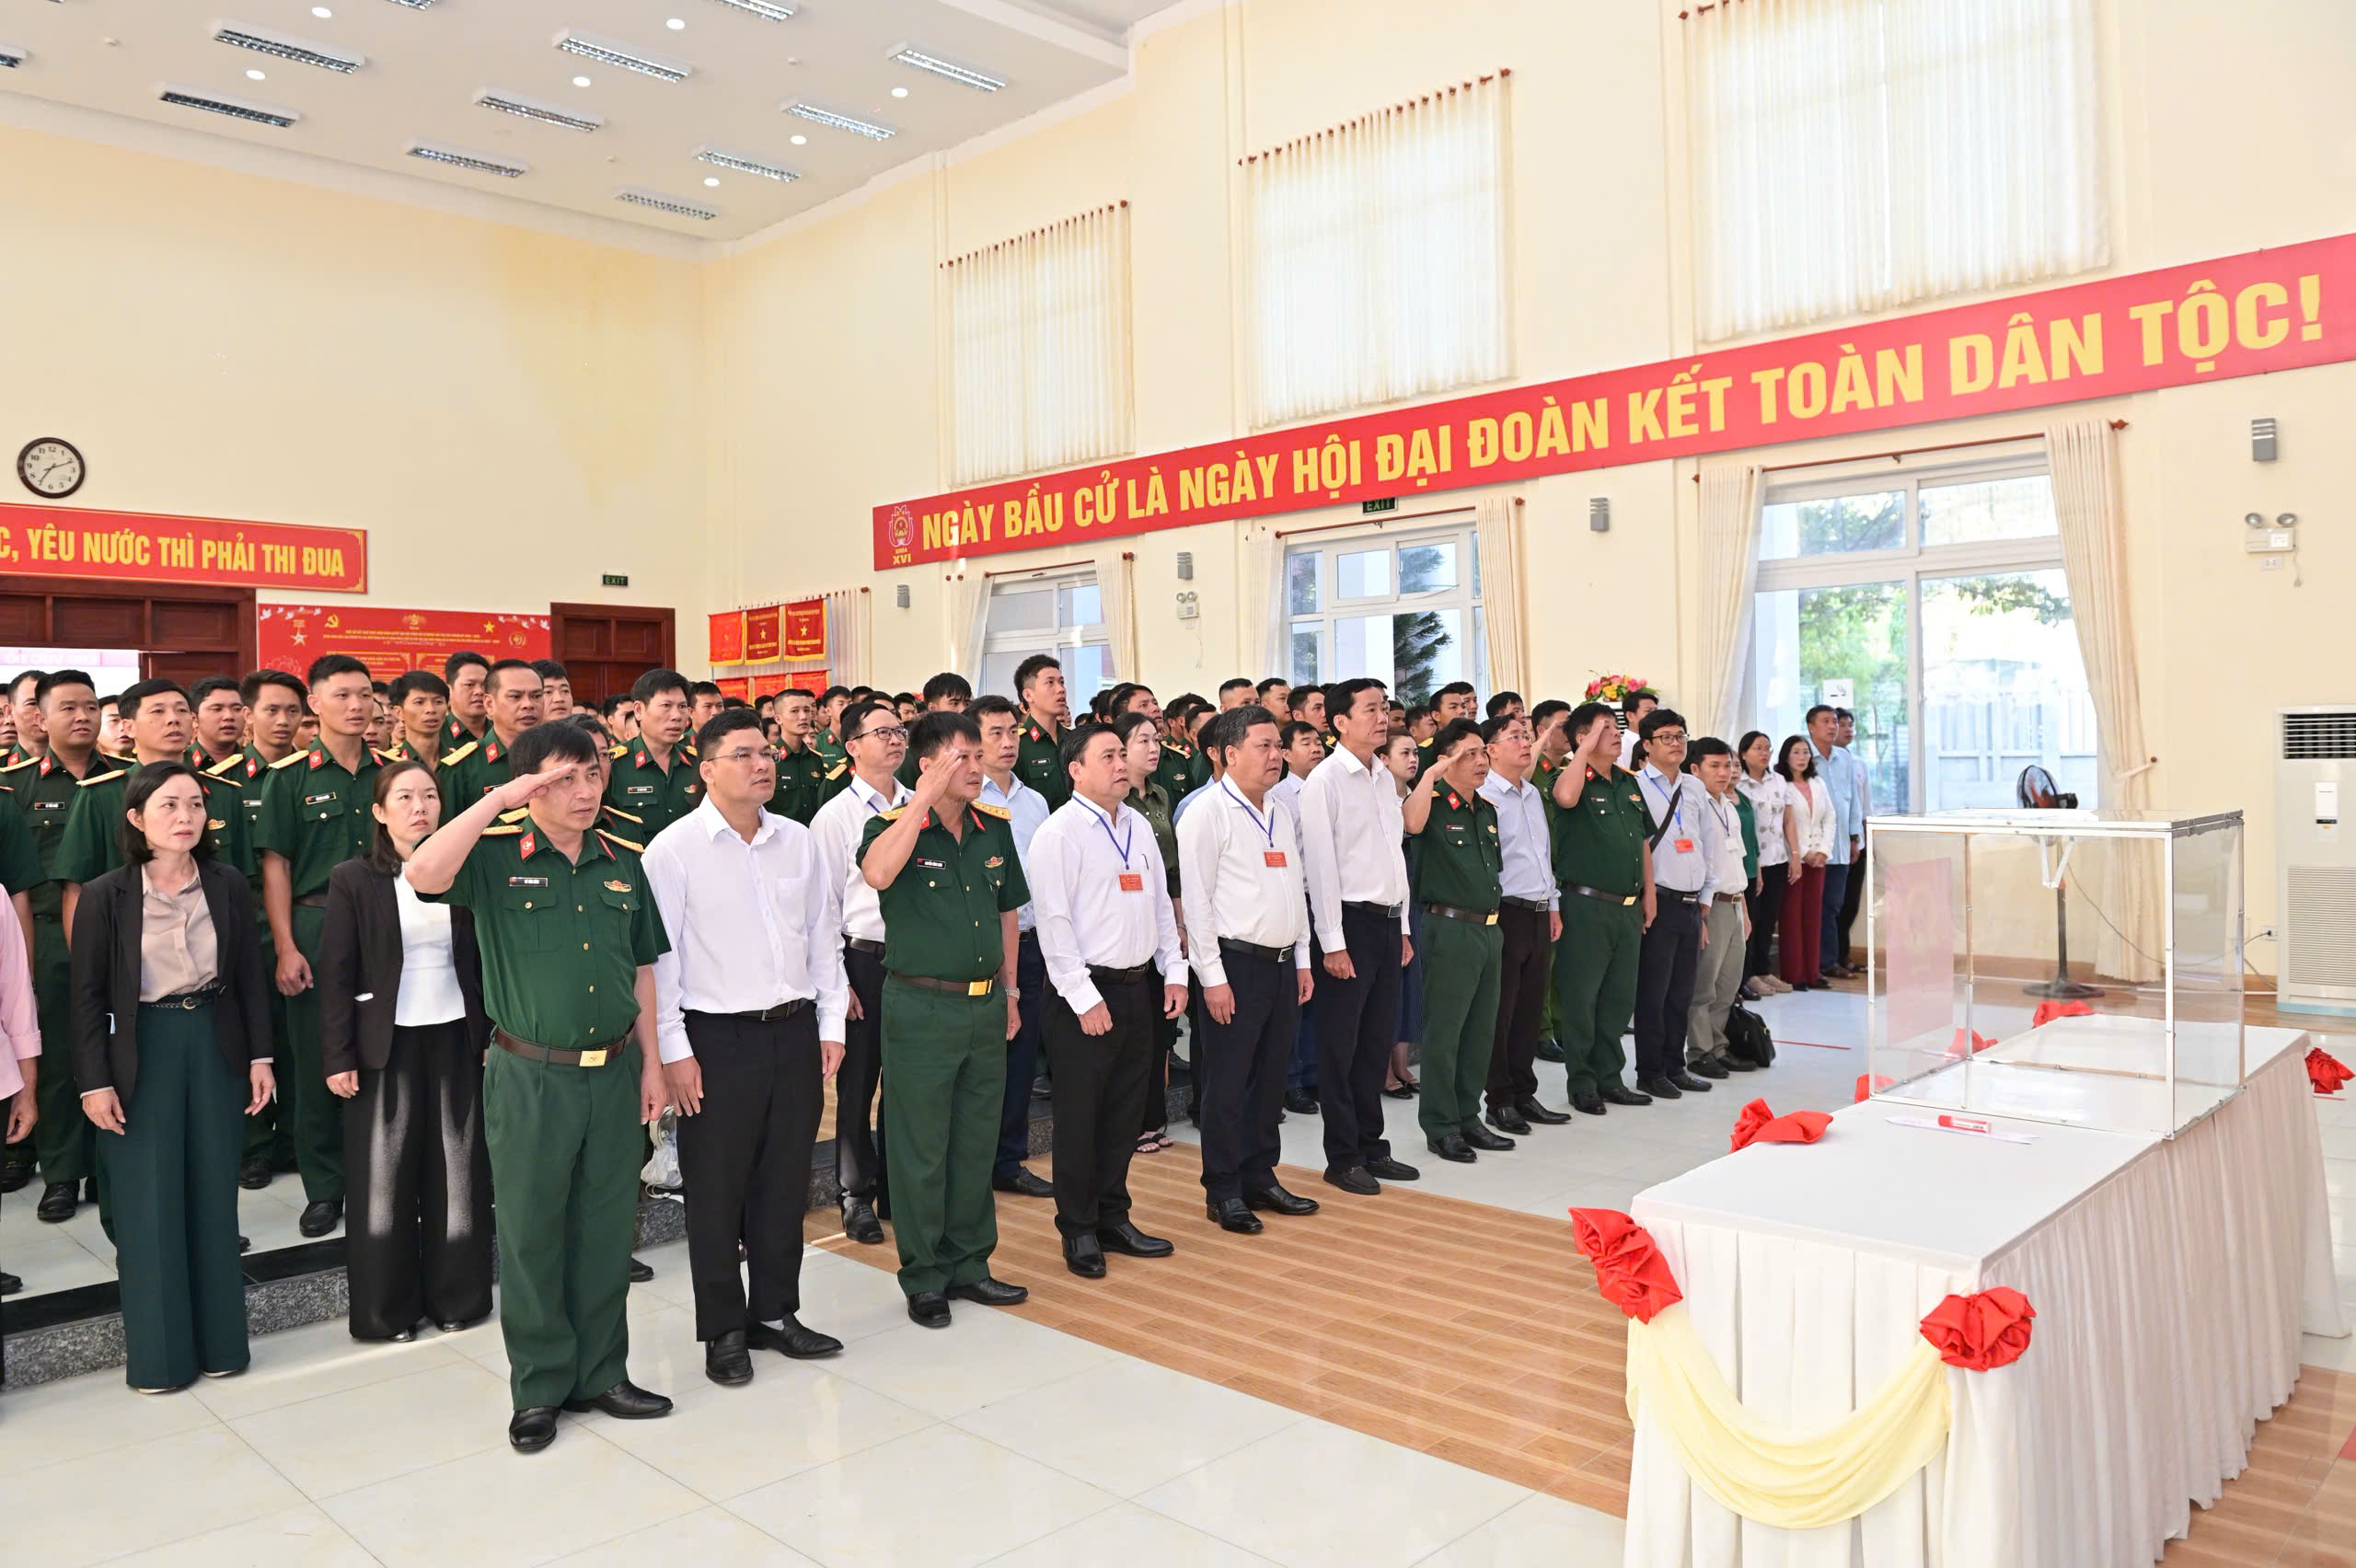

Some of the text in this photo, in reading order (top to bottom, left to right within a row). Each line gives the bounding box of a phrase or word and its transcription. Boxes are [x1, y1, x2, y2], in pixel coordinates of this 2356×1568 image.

[923, 274, 2323, 550] NGÀY BẦU CỬ LÀ NGÀY HỘI ĐẠI ĐOÀN KẾT TOÀN DÂN TỘC!
[26, 523, 75, 562] YÊU
[84, 528, 150, 566] NƯỚC
[158, 533, 194, 568] THÌ
[202, 532, 255, 571] PHẢI
[261, 544, 295, 574] THI
[302, 548, 345, 577] ĐUA
[893, 553, 911, 565] XVI
[605, 576, 626, 585] EXIT
